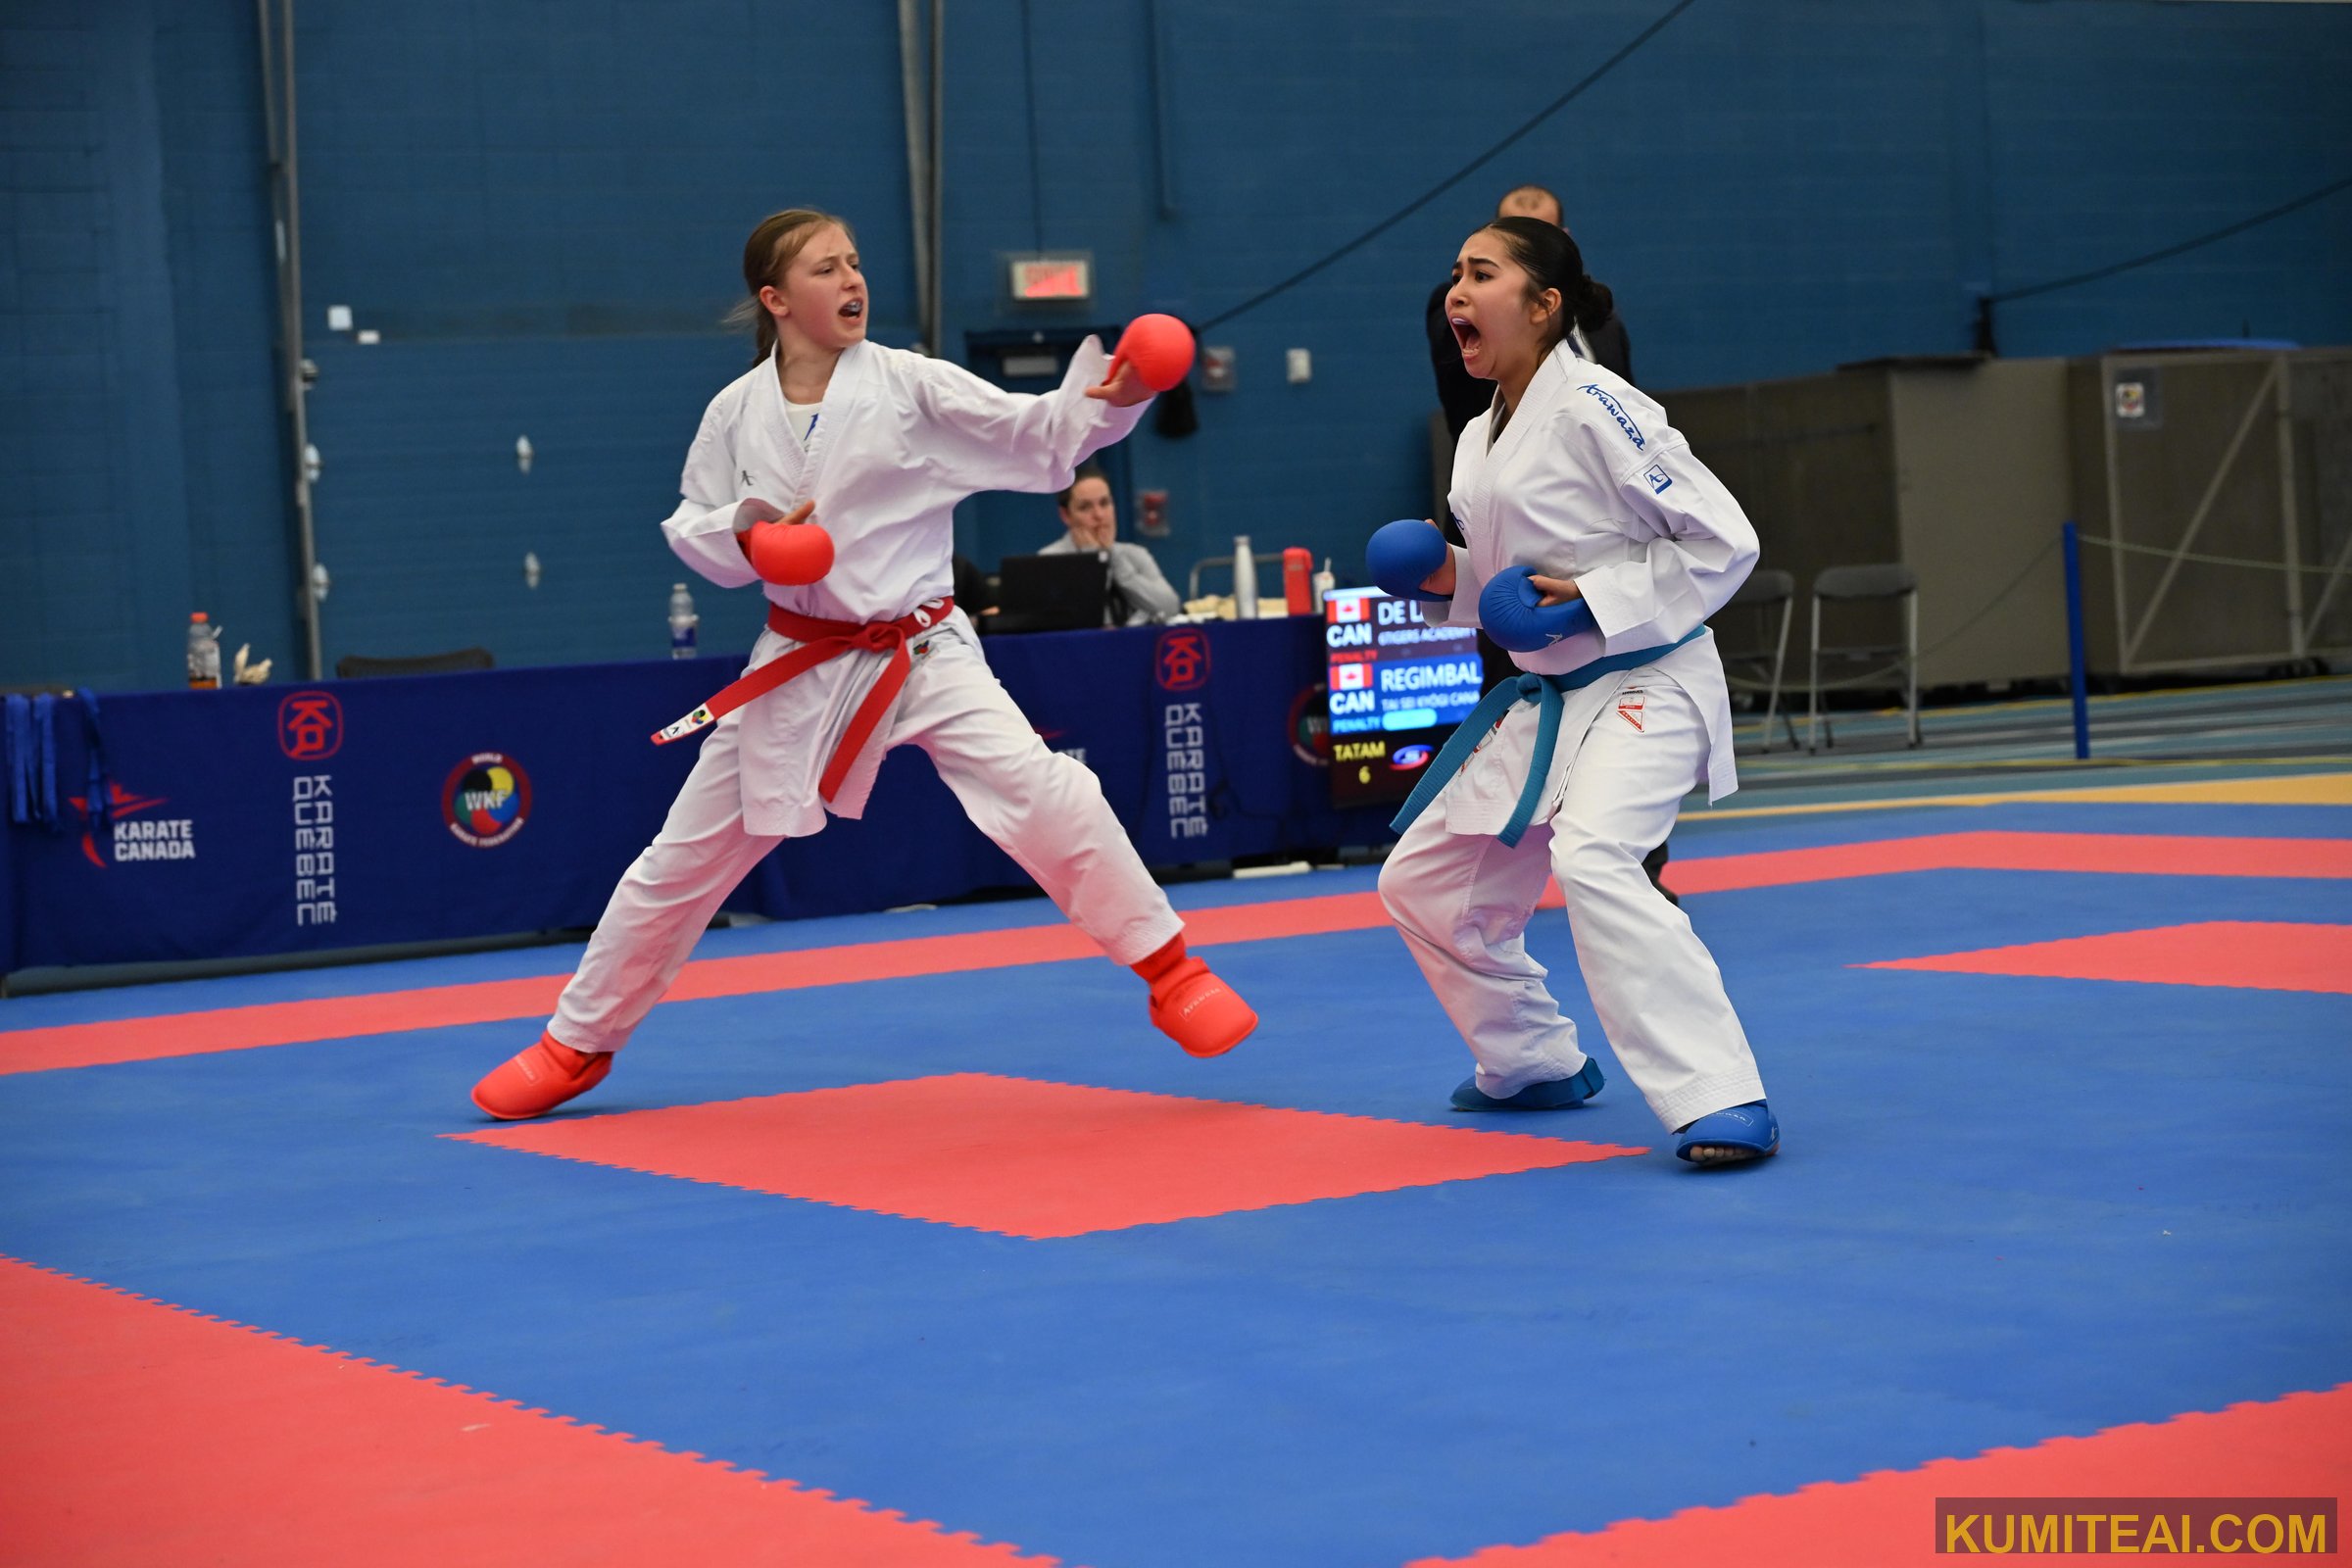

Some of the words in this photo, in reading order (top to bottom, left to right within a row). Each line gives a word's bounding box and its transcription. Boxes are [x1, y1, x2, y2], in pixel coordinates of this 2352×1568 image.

[1576, 384, 1645, 452] Arawaza
[1377, 600, 1406, 626] DE
[1326, 622, 1373, 648] CAN
[1330, 649, 1378, 664] PENALTY
[1380, 662, 1484, 693] REGIMBAL
[1329, 689, 1375, 715] CAN
[1332, 716, 1381, 734] PENALTY
[1358, 765, 1371, 784] 6
[465, 788, 508, 811] WKF
[114, 819, 193, 841] KARATE
[115, 840, 196, 861] CANADA
